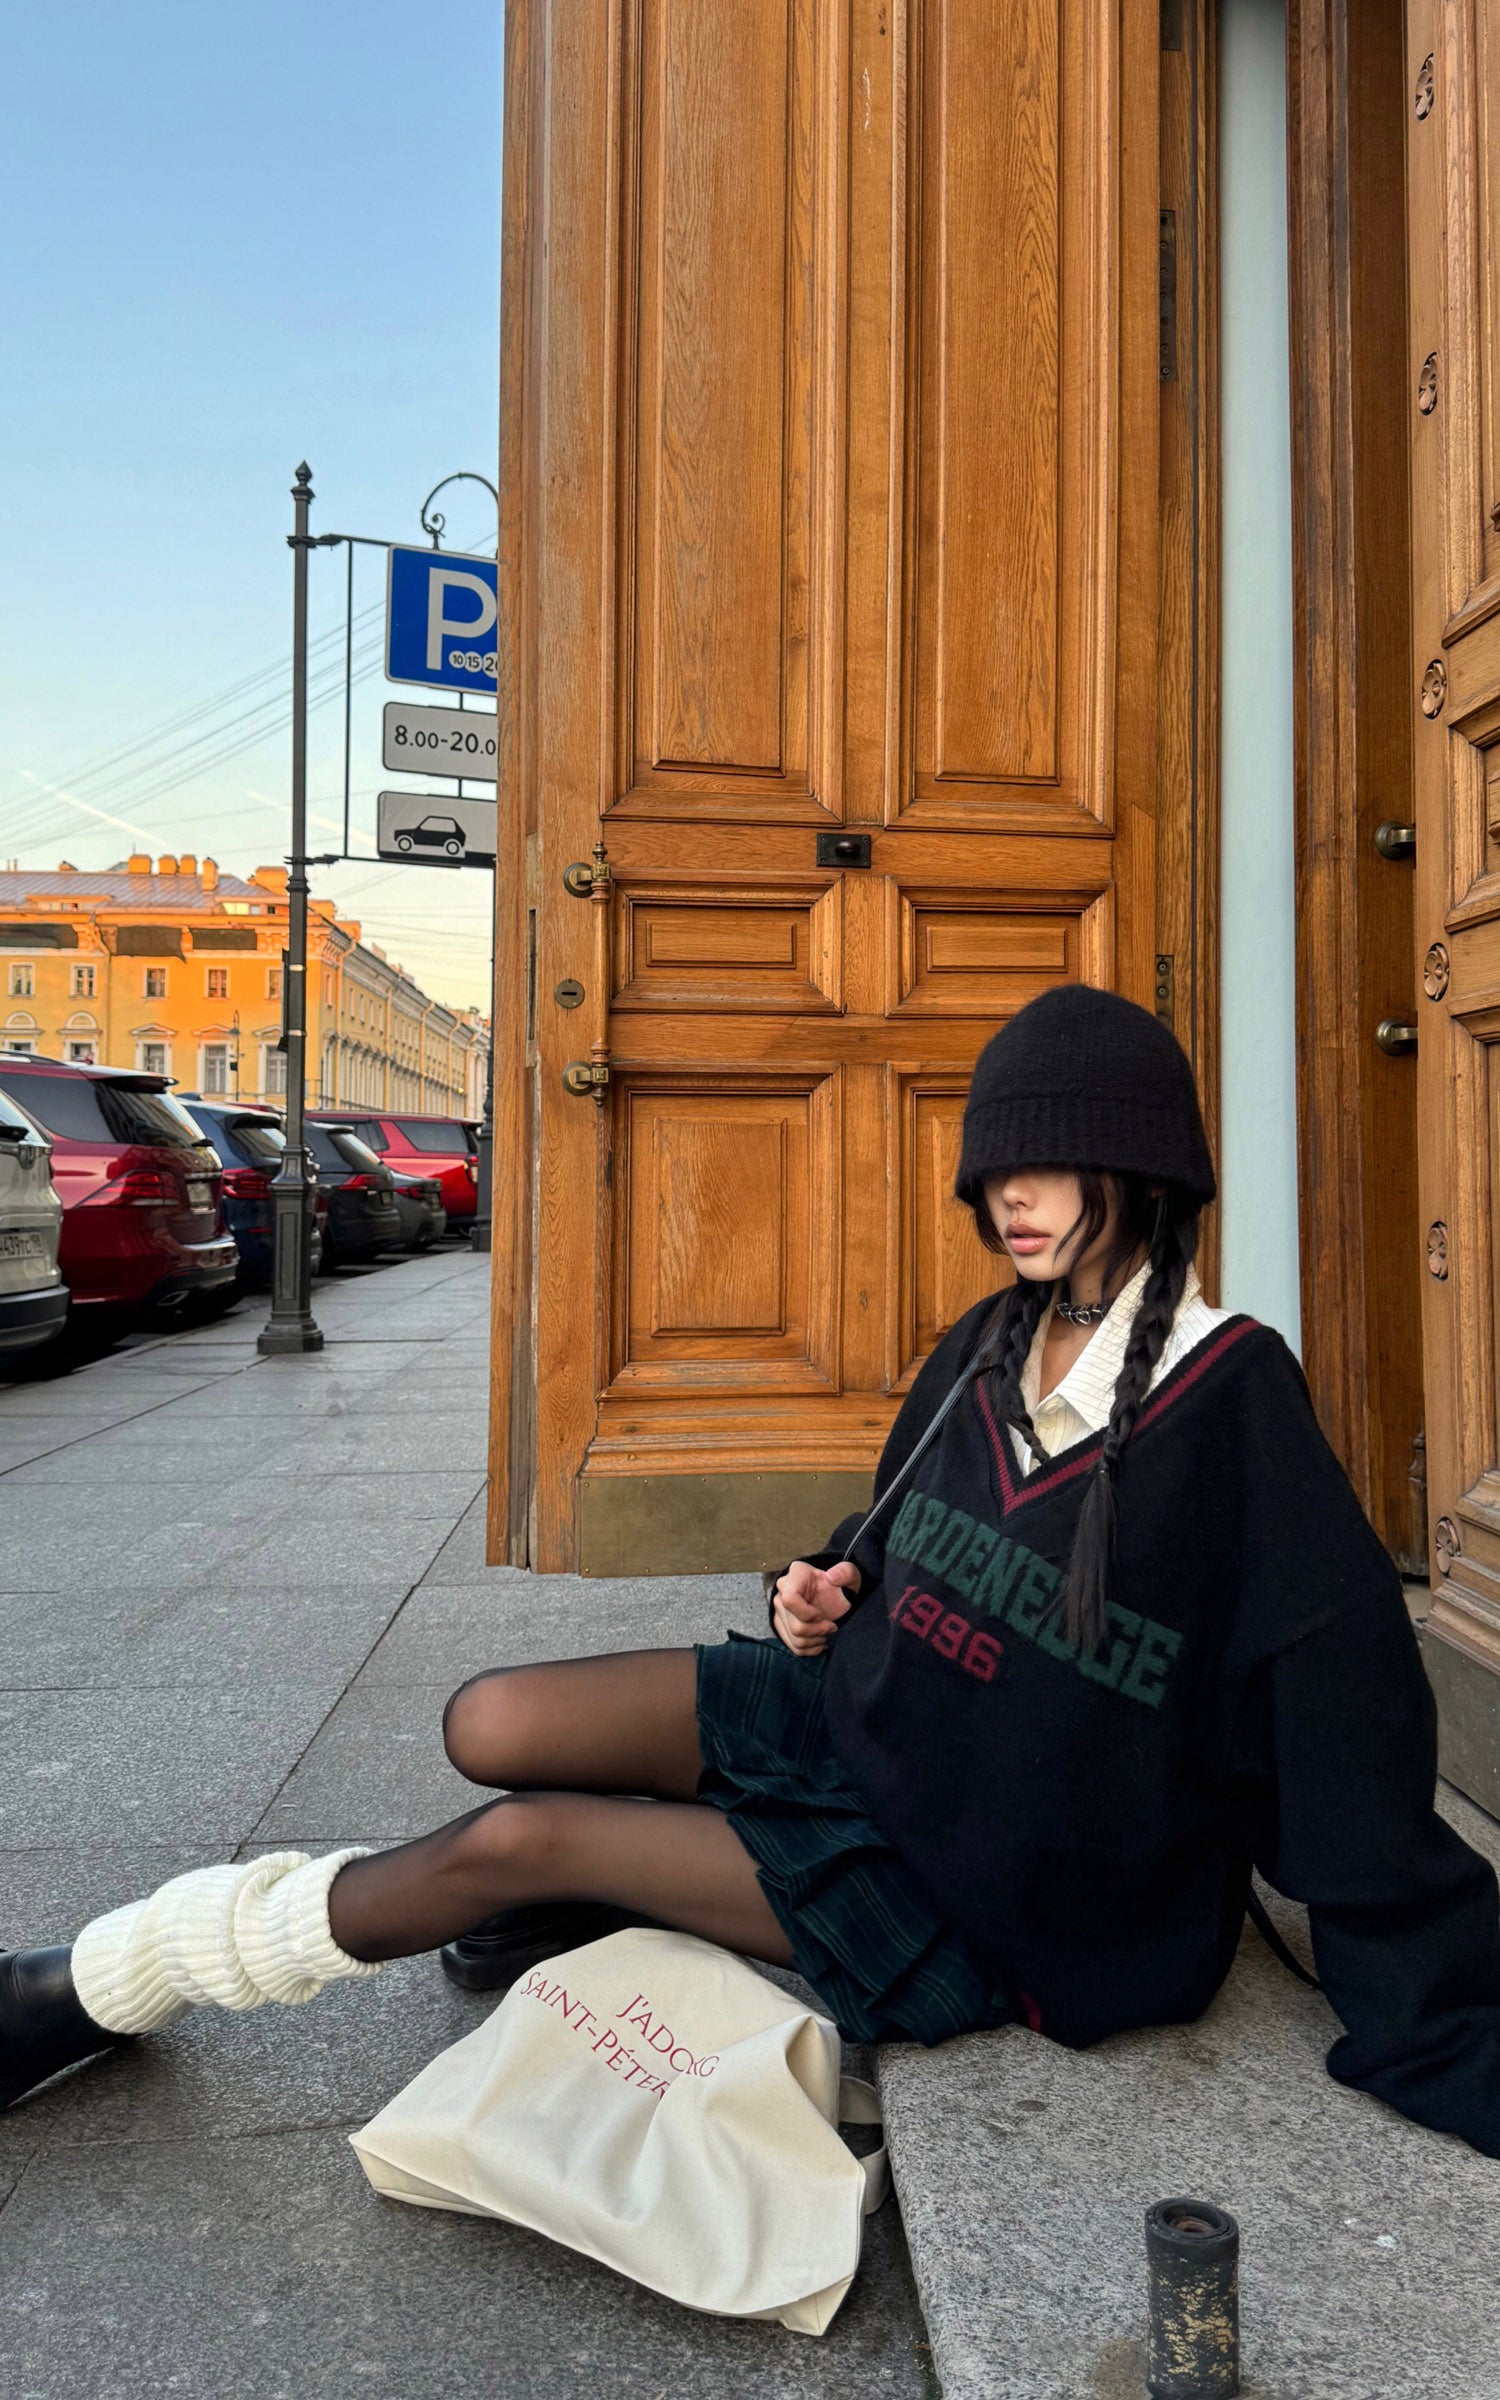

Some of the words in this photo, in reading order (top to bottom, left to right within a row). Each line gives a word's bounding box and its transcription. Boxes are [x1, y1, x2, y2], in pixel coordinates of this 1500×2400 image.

[426, 567, 497, 671] P
[452, 654, 464, 665] 10
[468, 656, 480, 668] 15
[889, 1585, 1004, 1682] 1996
